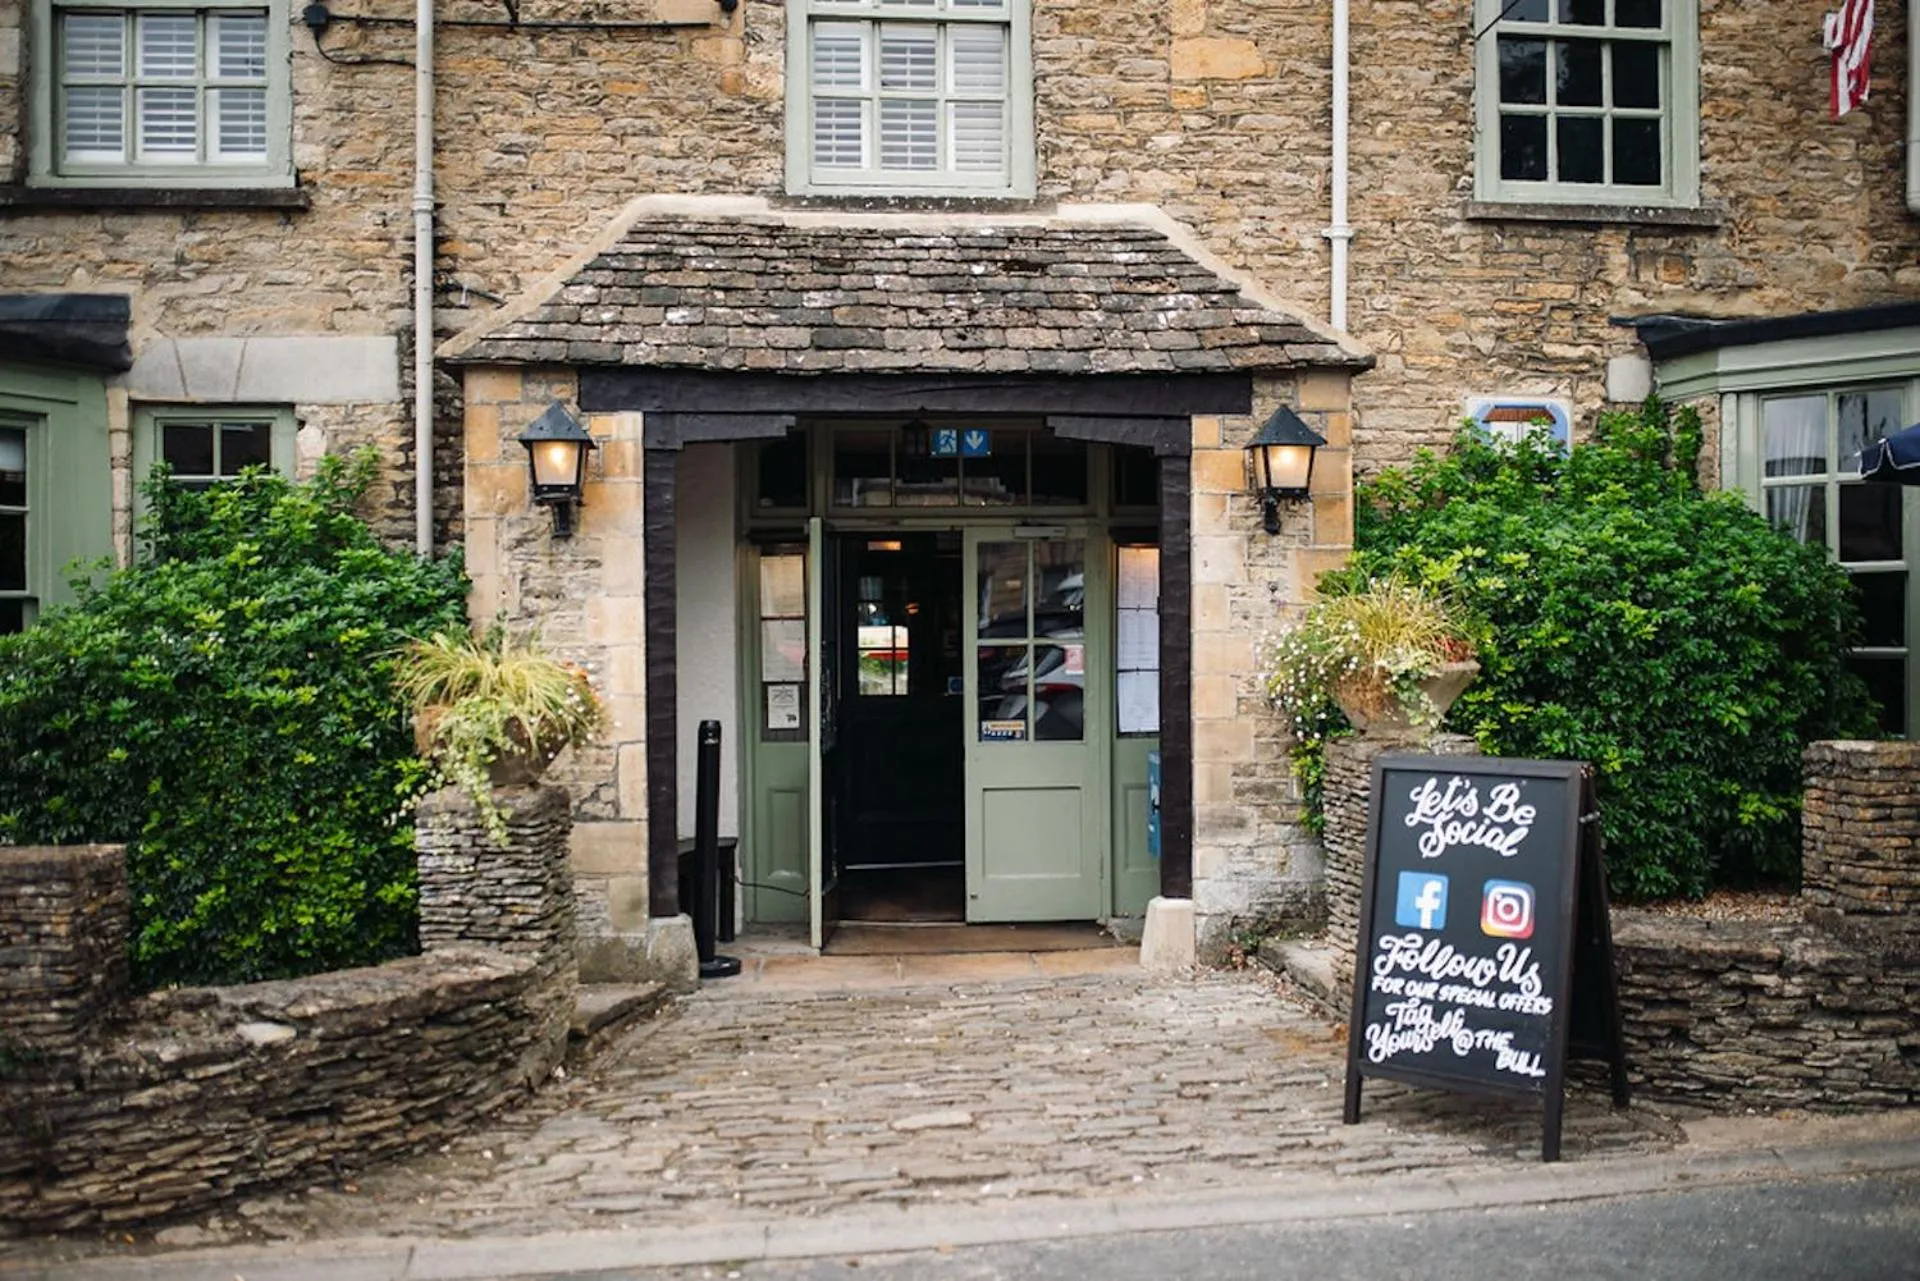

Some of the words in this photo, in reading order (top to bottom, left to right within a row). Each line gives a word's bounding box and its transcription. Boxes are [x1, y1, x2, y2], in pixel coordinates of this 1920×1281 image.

[1405, 776, 1479, 827] Let's
[1483, 783, 1536, 825] Be
[1419, 811, 1529, 858] Social
[1374, 933, 1497, 987] Follow
[1497, 942, 1542, 996] Us
[1372, 975, 1405, 994] FOR
[1405, 980, 1439, 999] OUR
[1439, 984, 1497, 1008] SPECIAL
[1499, 992, 1553, 1015] OFFERS
[1385, 998, 1433, 1032] Tag
[1496, 1049, 1546, 1077] BULL
